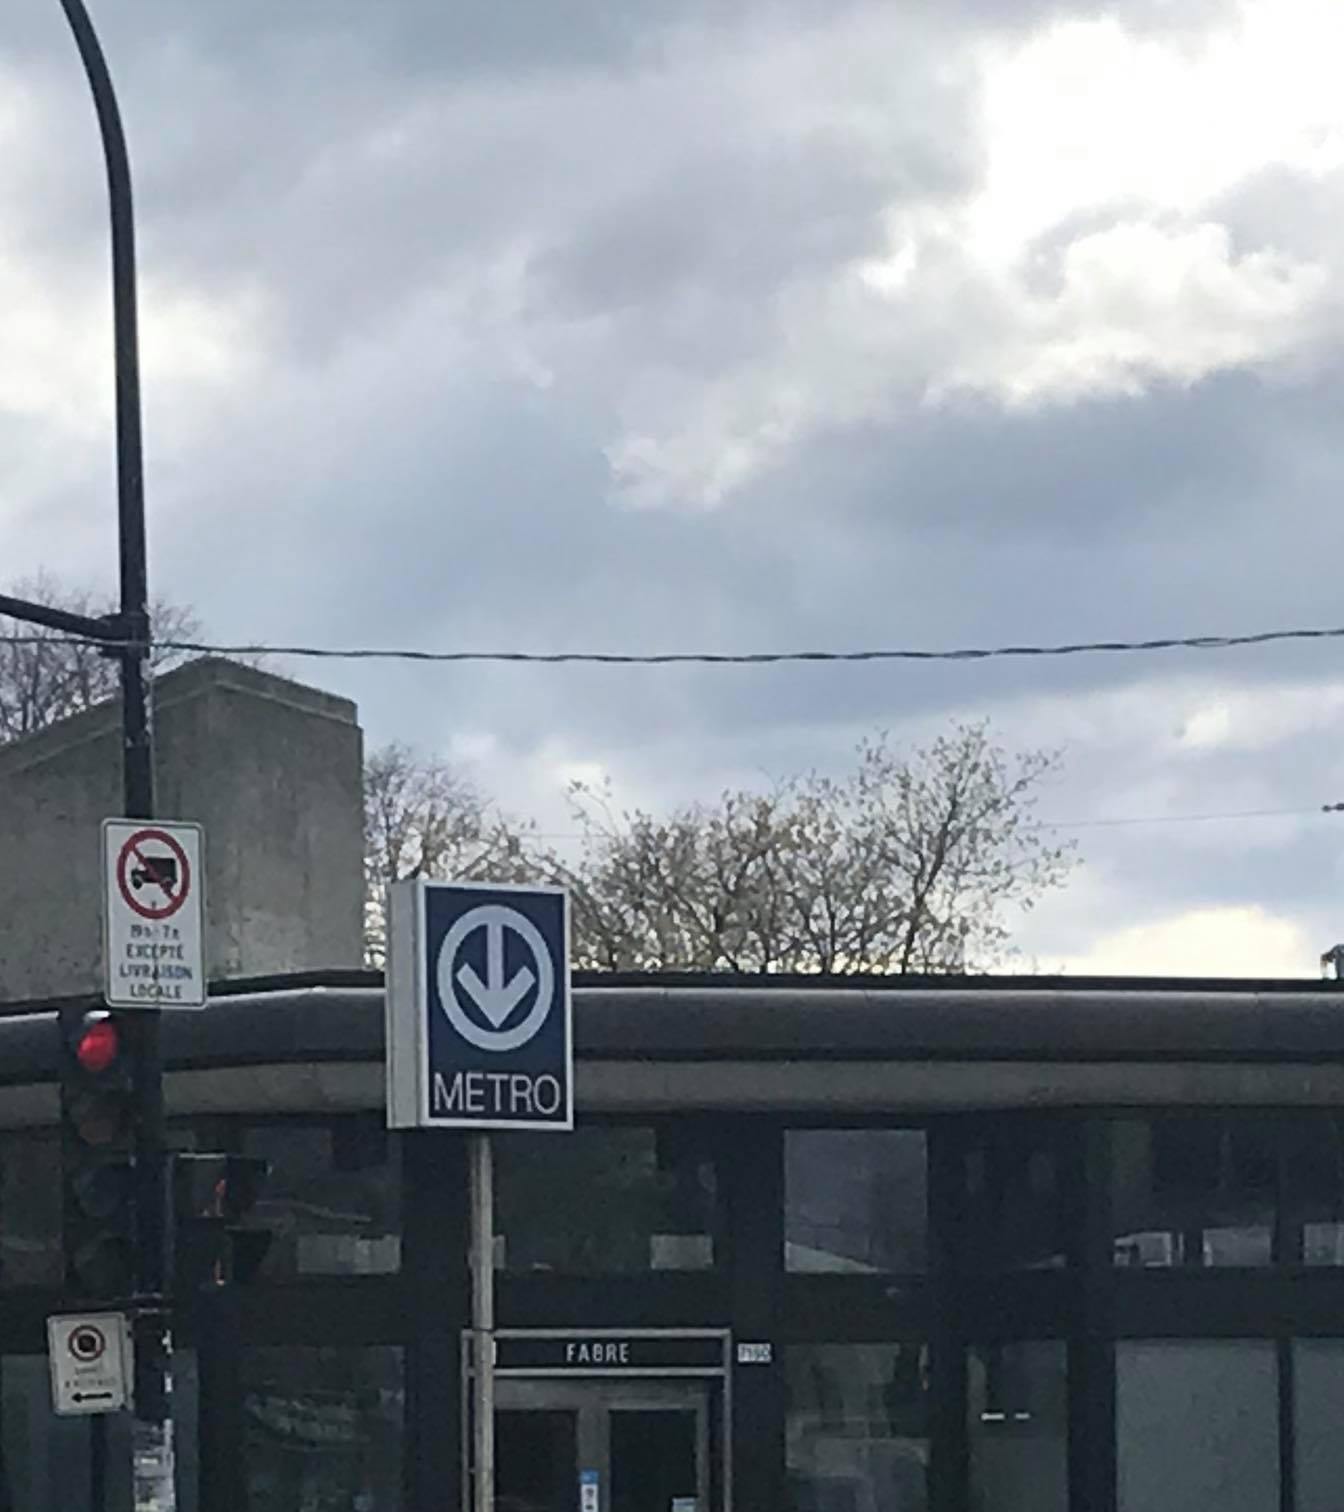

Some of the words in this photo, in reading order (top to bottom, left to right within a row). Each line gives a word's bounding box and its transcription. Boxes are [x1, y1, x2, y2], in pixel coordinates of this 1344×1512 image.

[130, 983, 183, 999] LOCALE
[433, 1072, 561, 1115] METRO
[566, 1343, 630, 1363] FABRE
